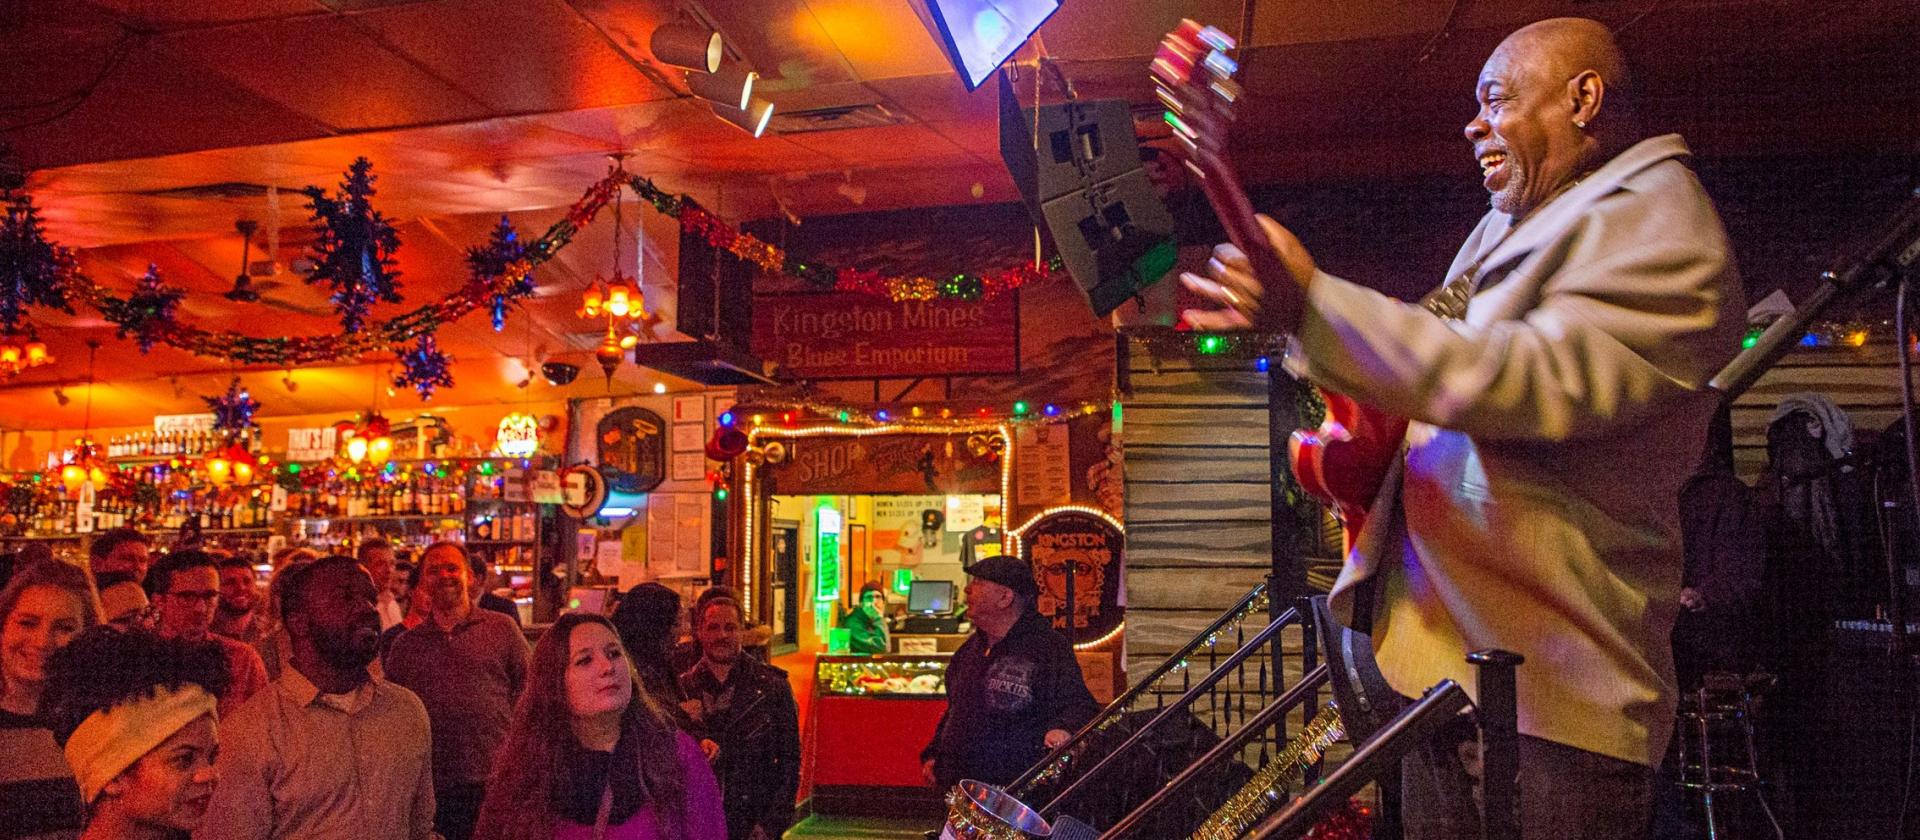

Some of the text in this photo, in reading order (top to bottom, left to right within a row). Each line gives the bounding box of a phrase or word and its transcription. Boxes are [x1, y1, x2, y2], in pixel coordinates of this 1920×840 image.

[773, 301, 984, 338] Kingston Mines
[786, 341, 967, 369] Blues Emporium
[799, 442, 860, 482] SHOP
[1038, 533, 1105, 547] KINGSTON
